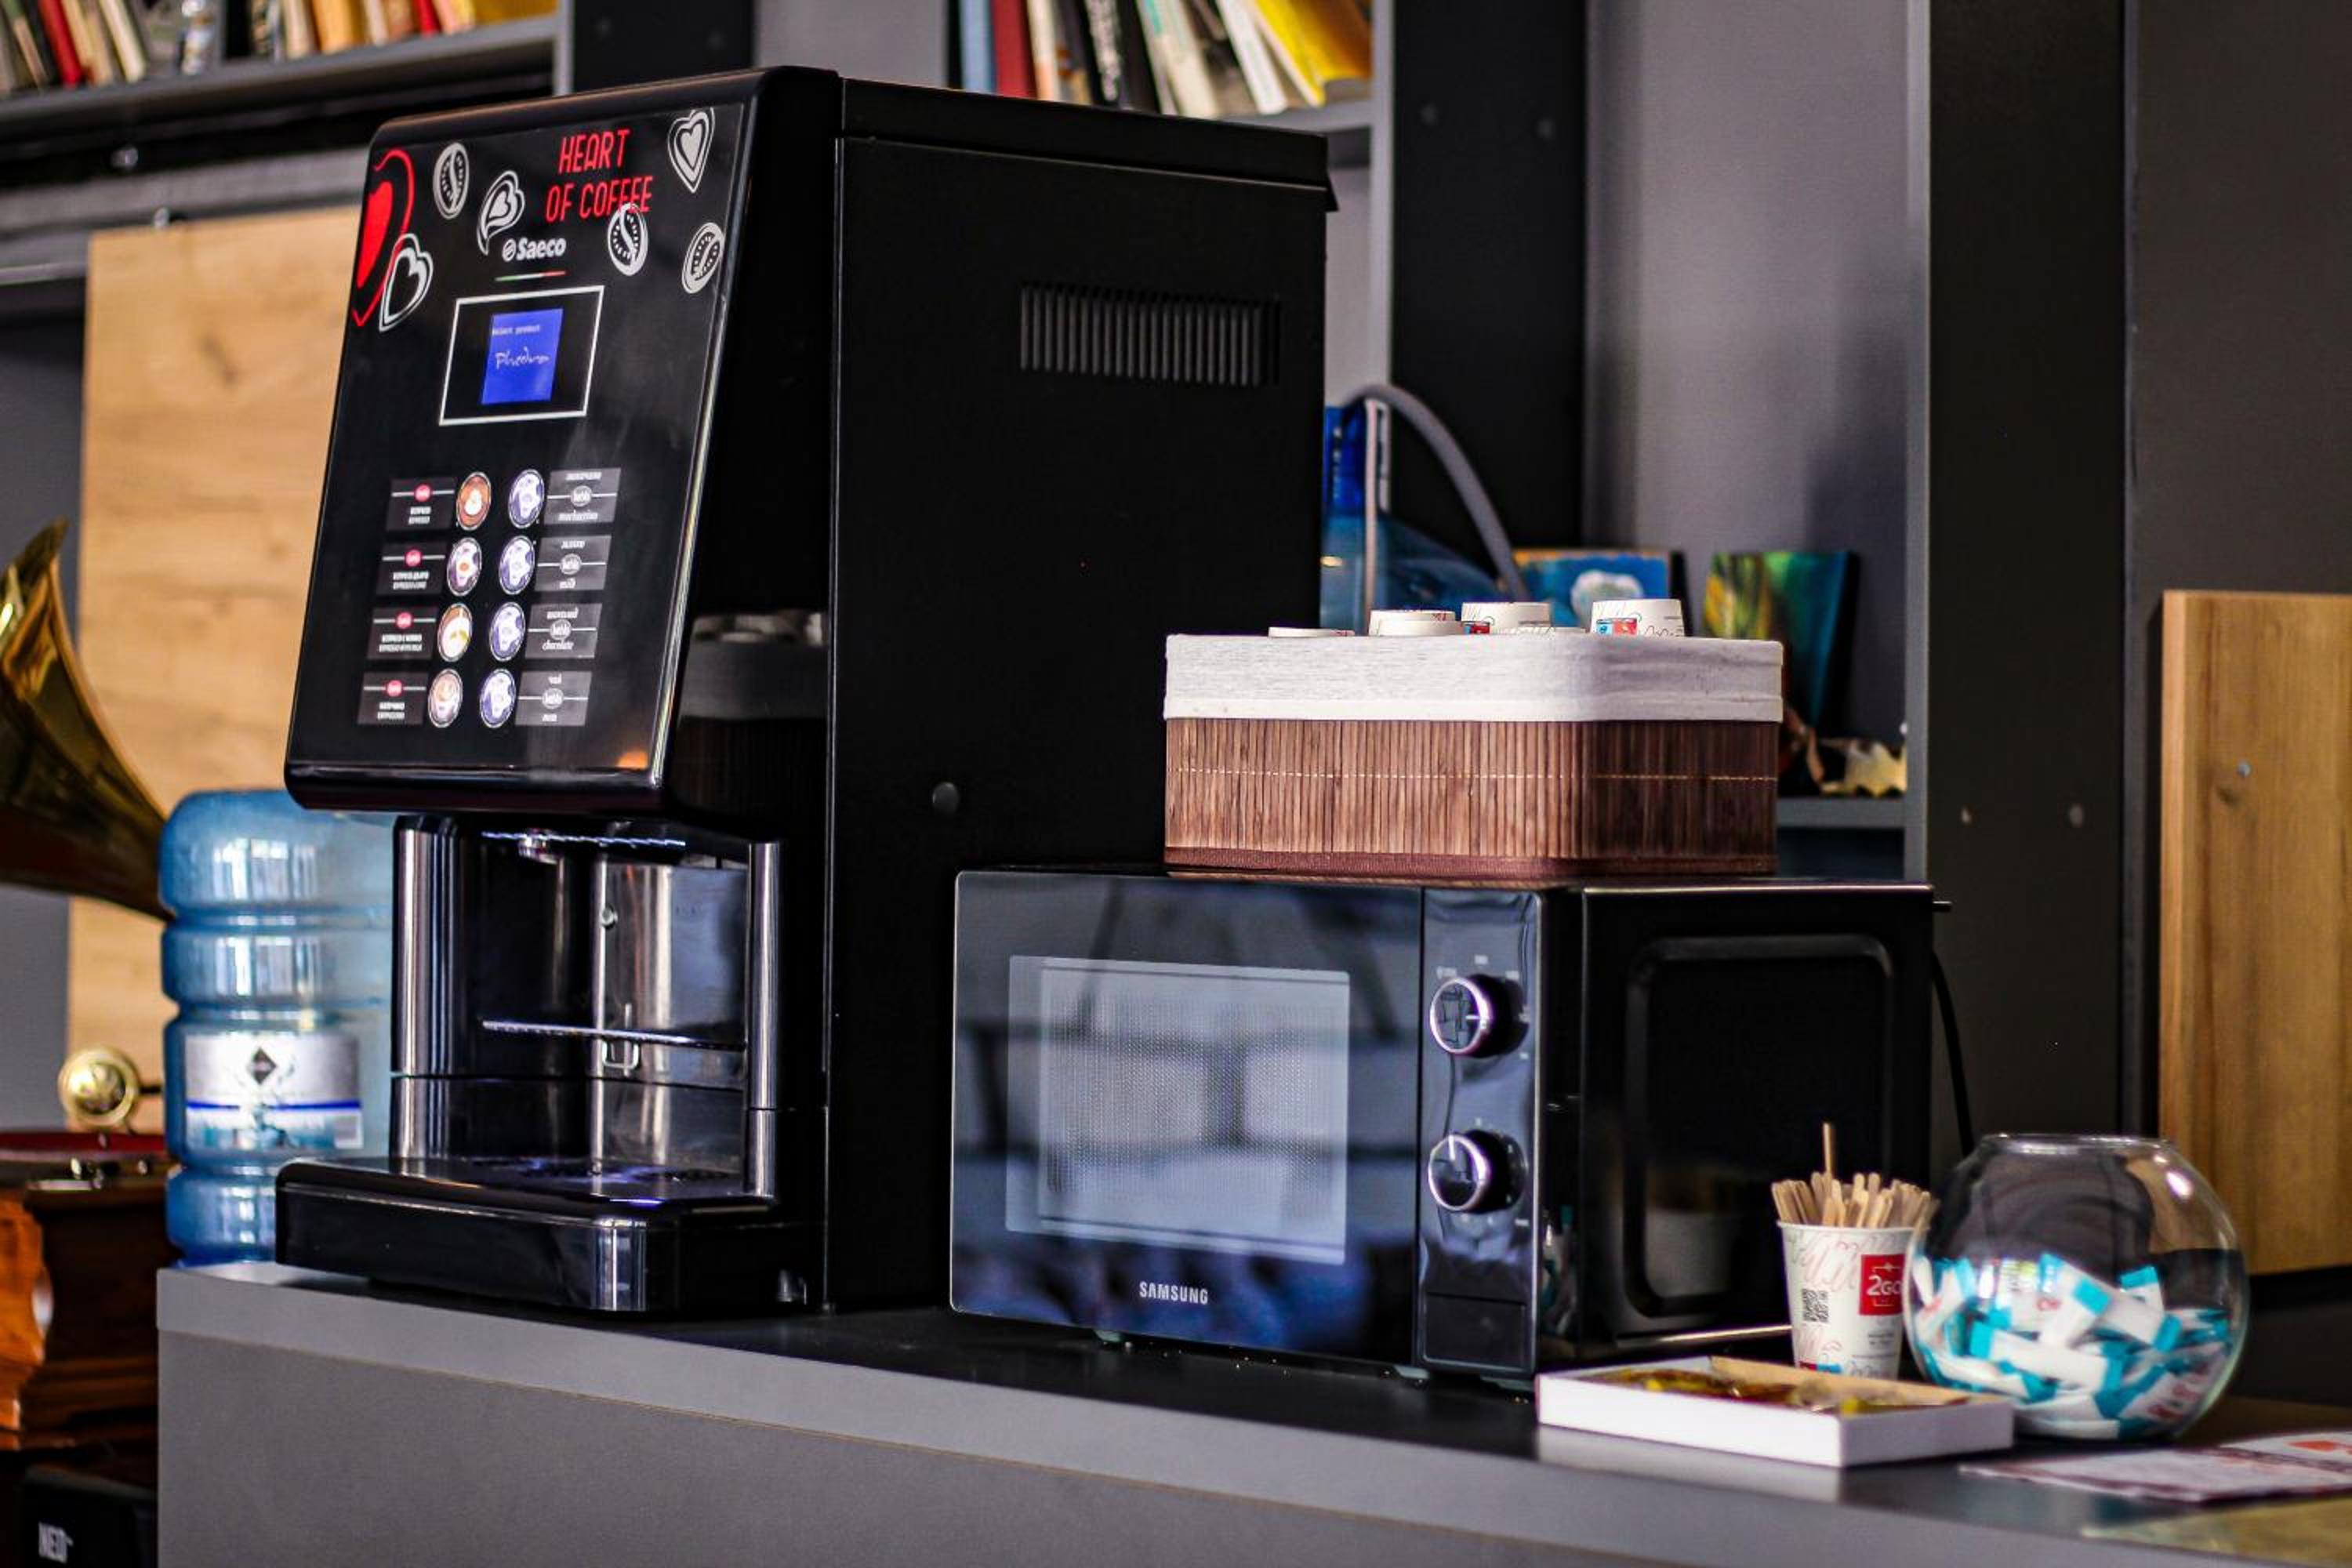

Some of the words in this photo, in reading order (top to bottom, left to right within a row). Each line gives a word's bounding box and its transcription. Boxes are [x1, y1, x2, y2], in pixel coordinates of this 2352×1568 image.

[558, 129, 630, 175] HEART
[546, 182, 575, 223] OF
[579, 176, 653, 219] COFFEE
[516, 237, 566, 261] Saeco
[1139, 1281, 1209, 1305] SAMSUNG
